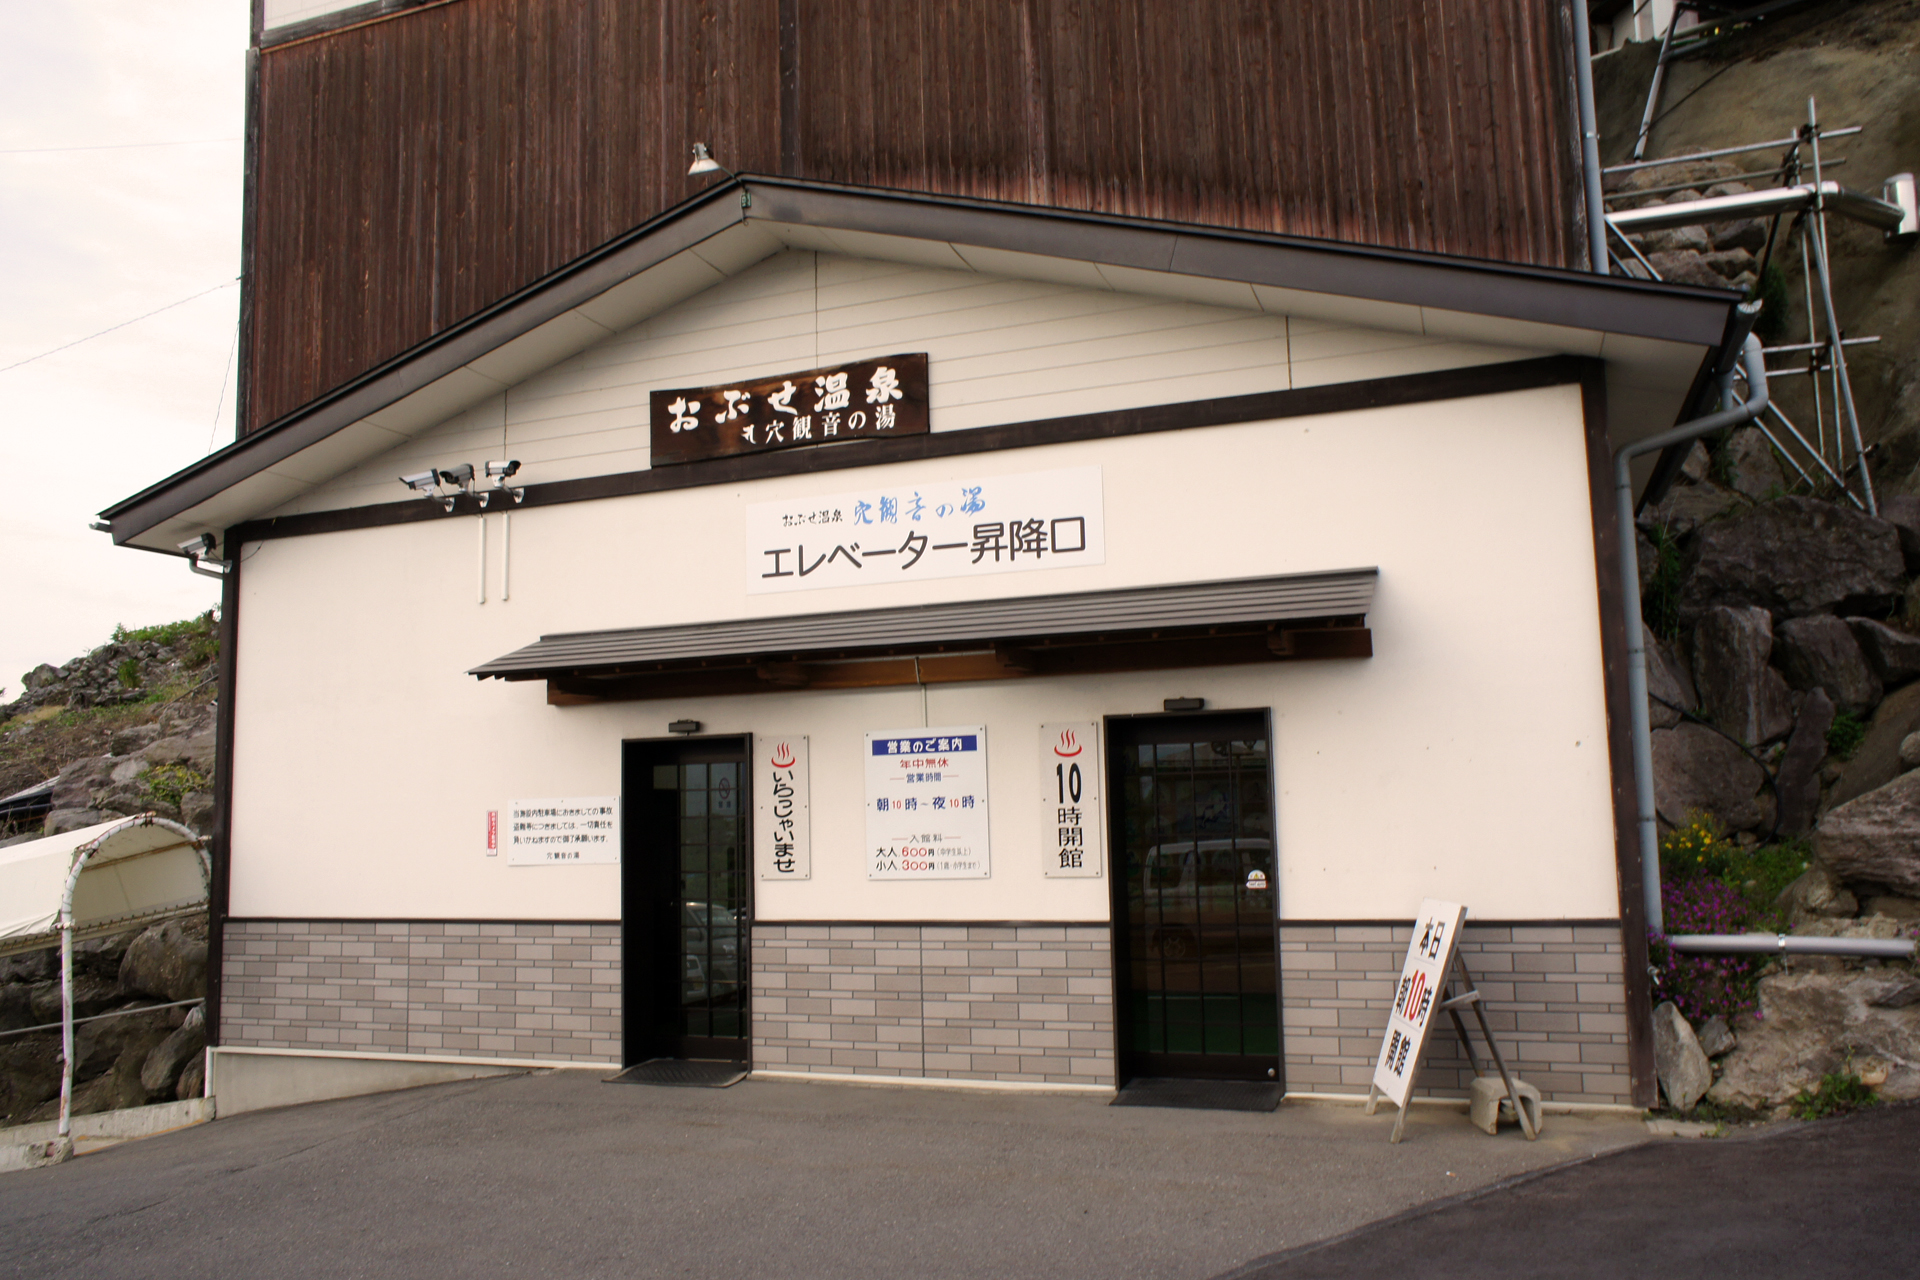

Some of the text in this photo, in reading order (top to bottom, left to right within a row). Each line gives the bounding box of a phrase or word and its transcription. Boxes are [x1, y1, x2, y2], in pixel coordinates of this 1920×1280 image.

[666, 366, 903, 434] おぶせ温泉
[782, 486, 986, 528] おぶせ温泉 穴観音の湯
[761, 516, 1086, 578] エレベーター昇降口
[887, 737, 963, 754] 営業のご案内
[899, 757, 949, 769] 年中無休
[906, 772, 942, 783] 営業時間
[773, 770, 796, 873] いらっしゃいませ
[909, 834, 943, 844] 入館料
[1418, 916, 1446, 960] 本日
